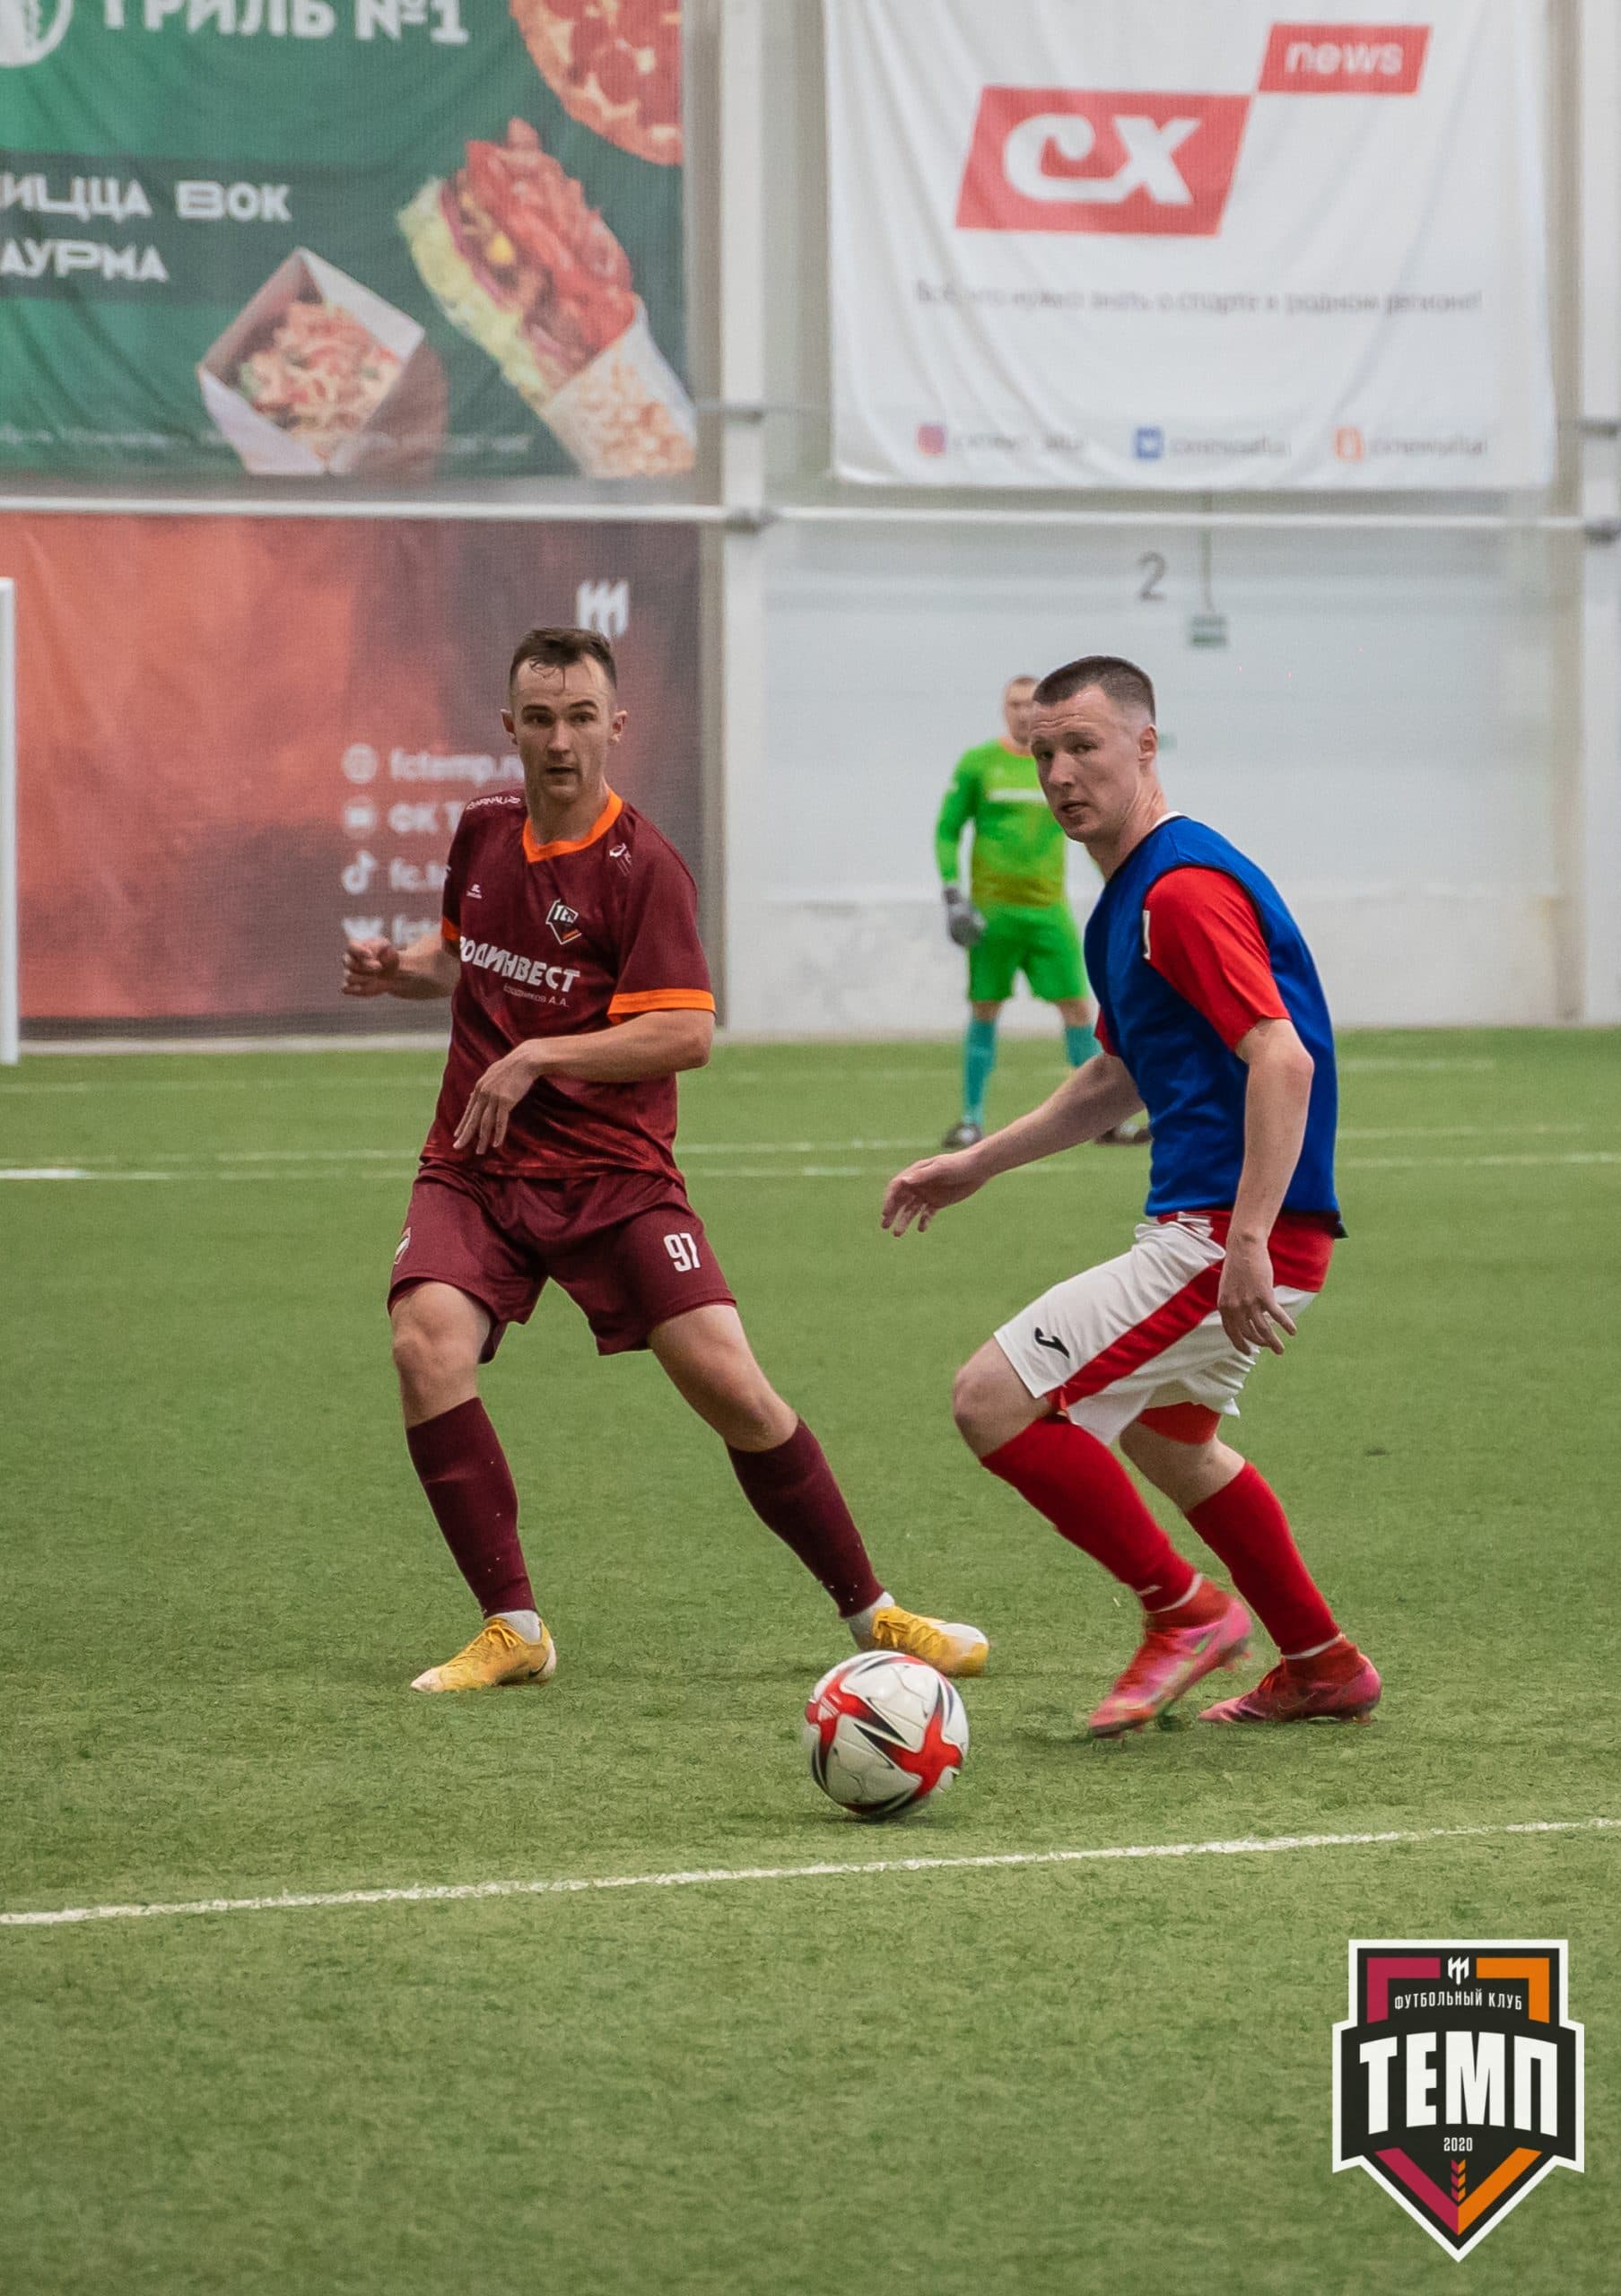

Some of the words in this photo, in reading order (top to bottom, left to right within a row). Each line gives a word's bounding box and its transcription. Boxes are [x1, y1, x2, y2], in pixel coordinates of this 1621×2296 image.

[1284, 41, 1404, 75] news
[1137, 552, 1165, 602] 2
[664, 1232, 701, 1272] 97
